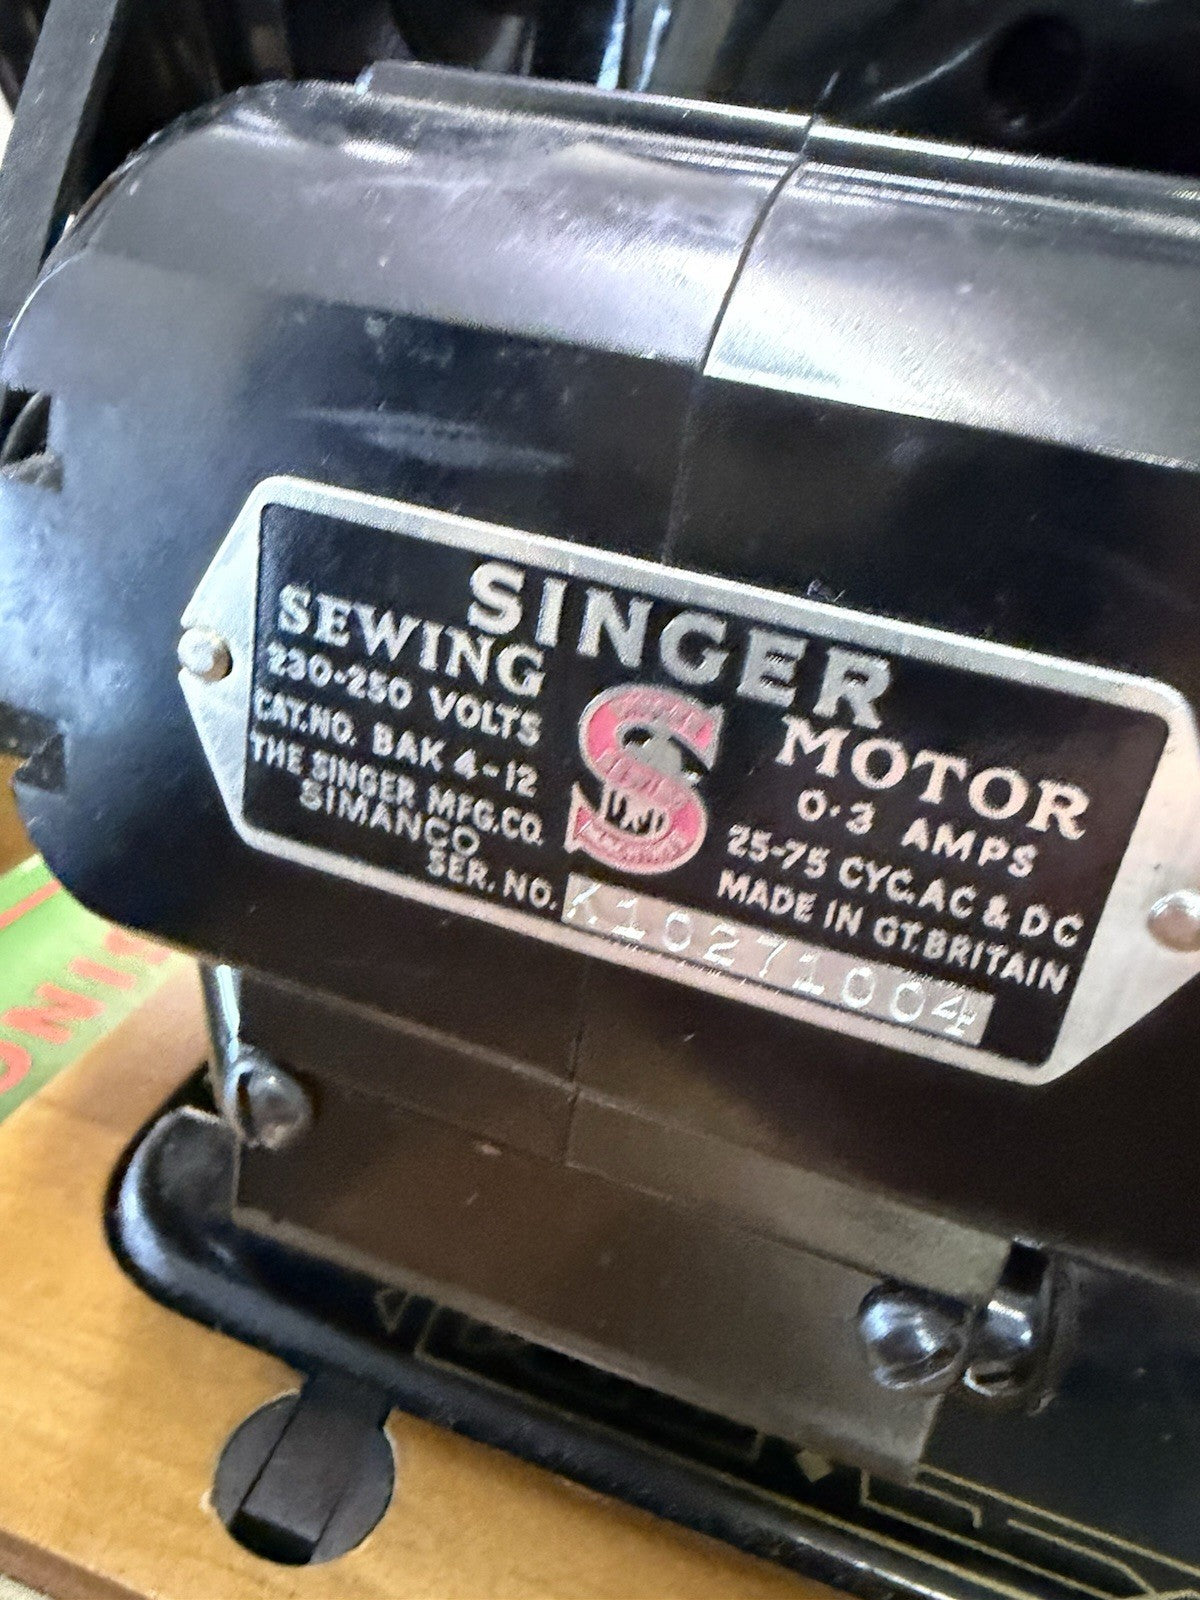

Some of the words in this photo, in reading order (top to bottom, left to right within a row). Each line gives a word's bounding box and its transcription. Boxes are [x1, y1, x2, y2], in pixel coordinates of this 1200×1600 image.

[277, 583, 546, 698] SEWING
[467, 561, 892, 729] SINGER
[267, 641, 413, 710] 230-250
[429, 685, 544, 747] VOLTS
[250, 730, 306, 776] THE
[312, 749, 417, 808] SINGER
[372, 721, 446, 773] BAK
[454, 748, 539, 799] 4-12
[775, 714, 1091, 841] MOTOR
[299, 778, 481, 858] SIMANCO
[902, 816, 1039, 878] AMPS
[427, 849, 496, 893] SER.
[503, 868, 559, 911] NO.
[716, 869, 816, 923] MADE
[824, 899, 864, 938] IN
[728, 822, 830, 879] 25-75
[983, 894, 1011, 931] &
[1019, 903, 1085, 948] DC
